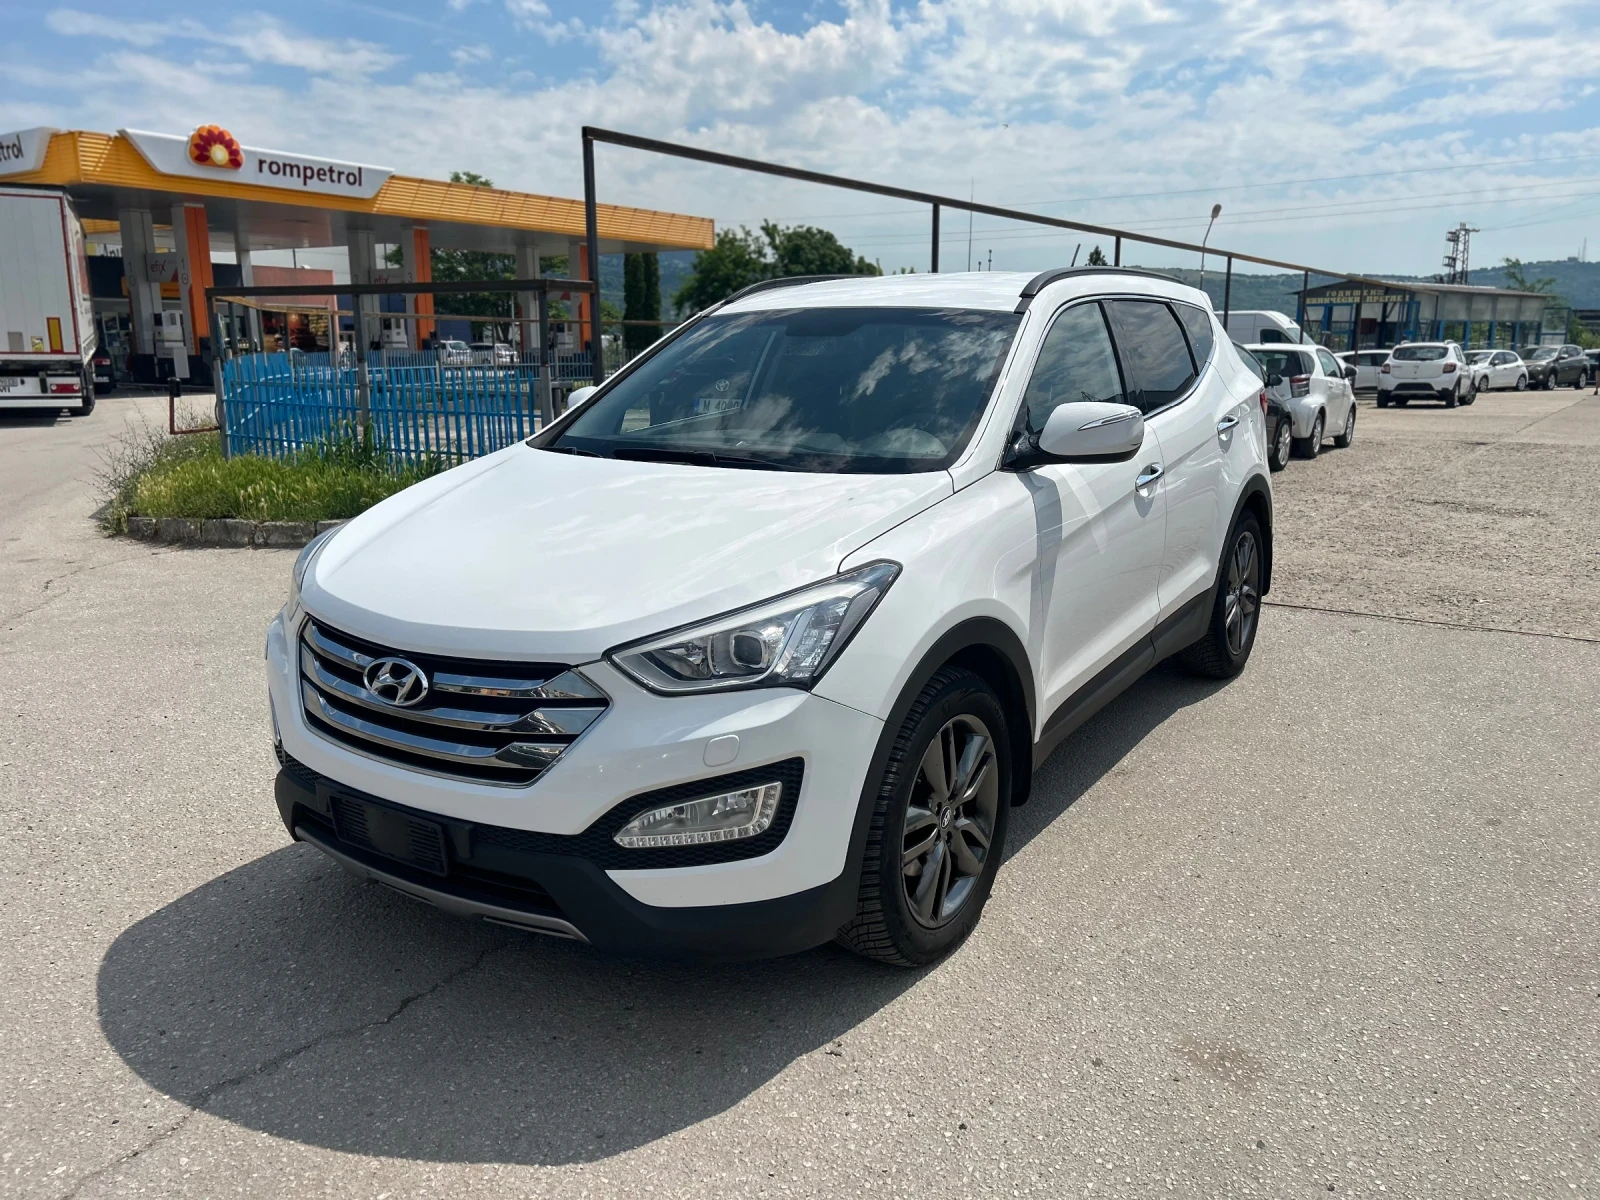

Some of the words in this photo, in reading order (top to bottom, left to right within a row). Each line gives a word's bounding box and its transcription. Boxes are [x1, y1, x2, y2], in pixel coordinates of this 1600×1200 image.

[0, 133, 24, 162] trol
[257, 158, 363, 187] rompetrol
[1305, 296, 1360, 304] ЕХНИЧЕСКИ
